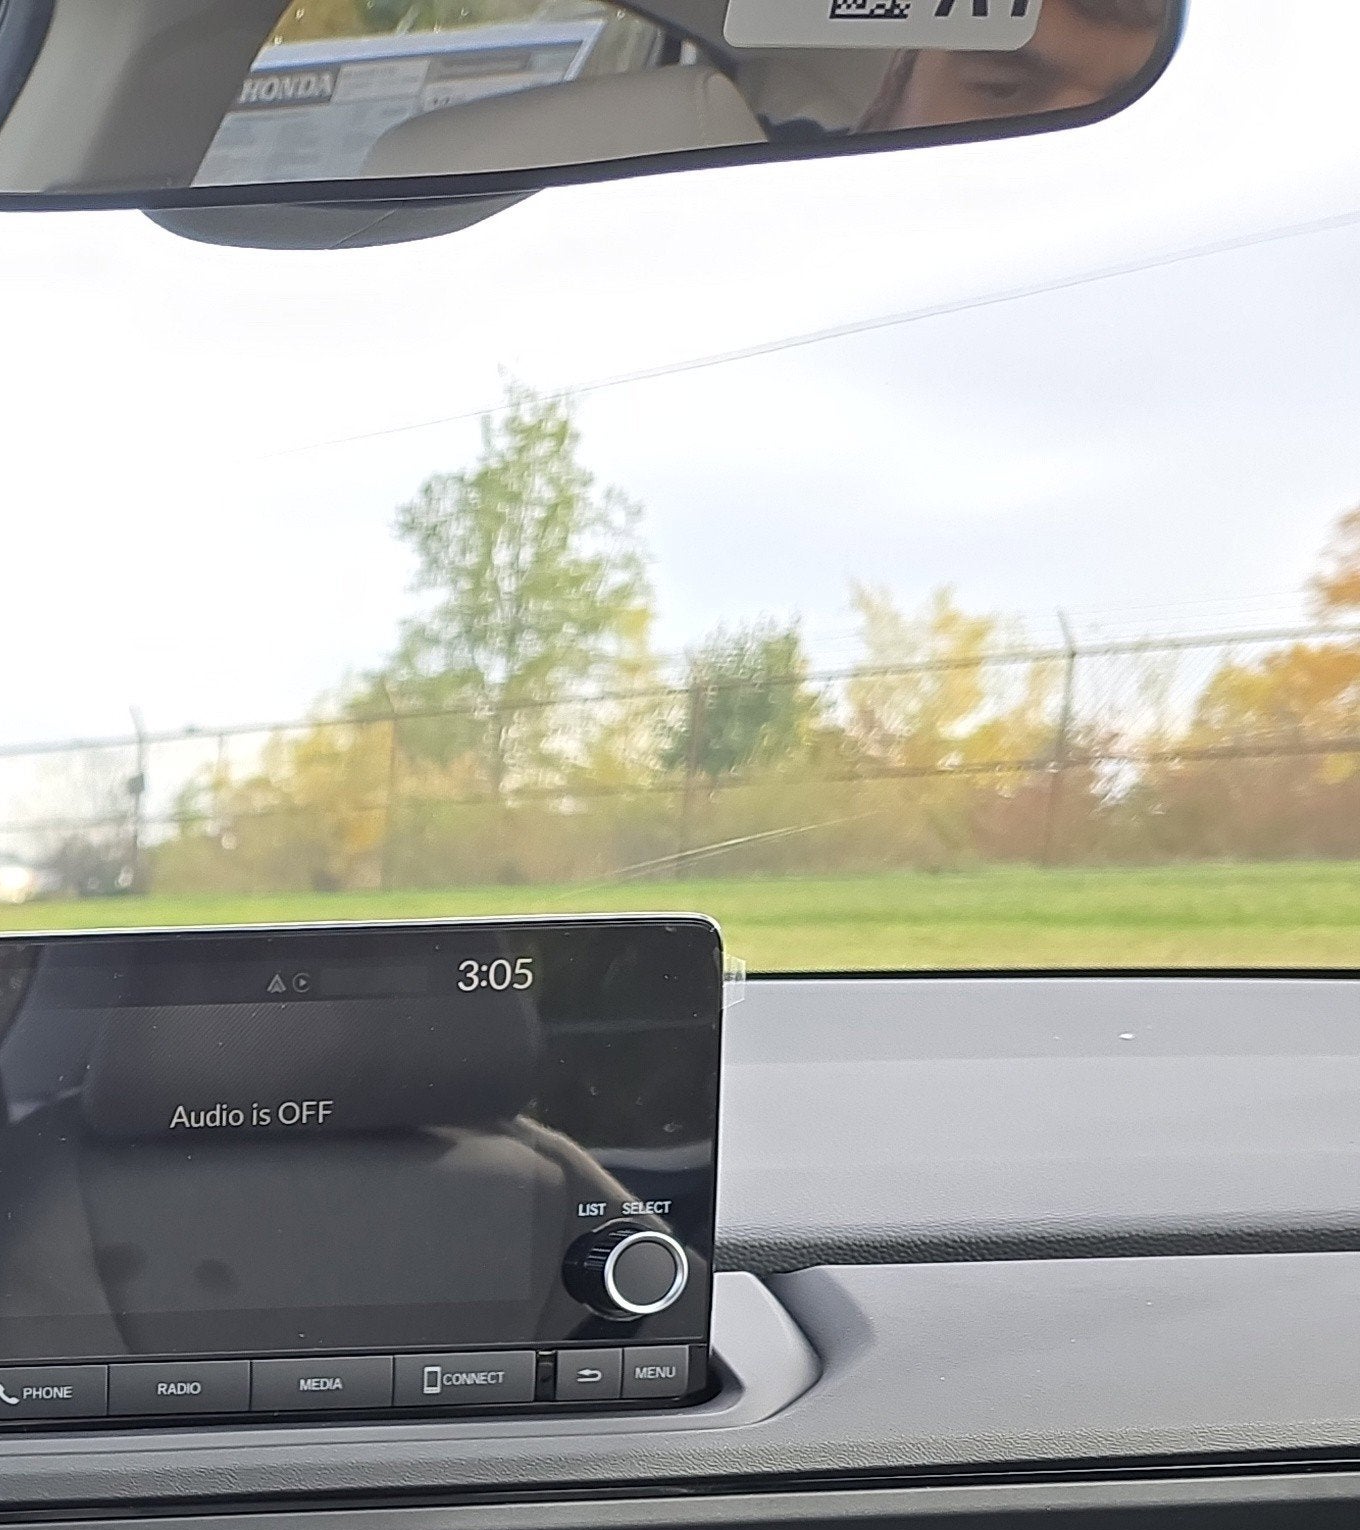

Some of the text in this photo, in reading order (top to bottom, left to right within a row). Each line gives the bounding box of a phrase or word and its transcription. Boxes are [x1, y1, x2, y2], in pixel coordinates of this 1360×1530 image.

[239, 72, 331, 104] HONDA
[457, 957, 534, 992] 3:05
[169, 1100, 333, 1128] Audio is OFF
[578, 1200, 672, 1217] LIST SELECT
[443, 1371, 506, 1387] CONNECT
[634, 1365, 676, 1380] MENU
[22, 1384, 73, 1400] PHONE
[157, 1381, 202, 1397] RADIO
[299, 1377, 343, 1392] MEDIA
